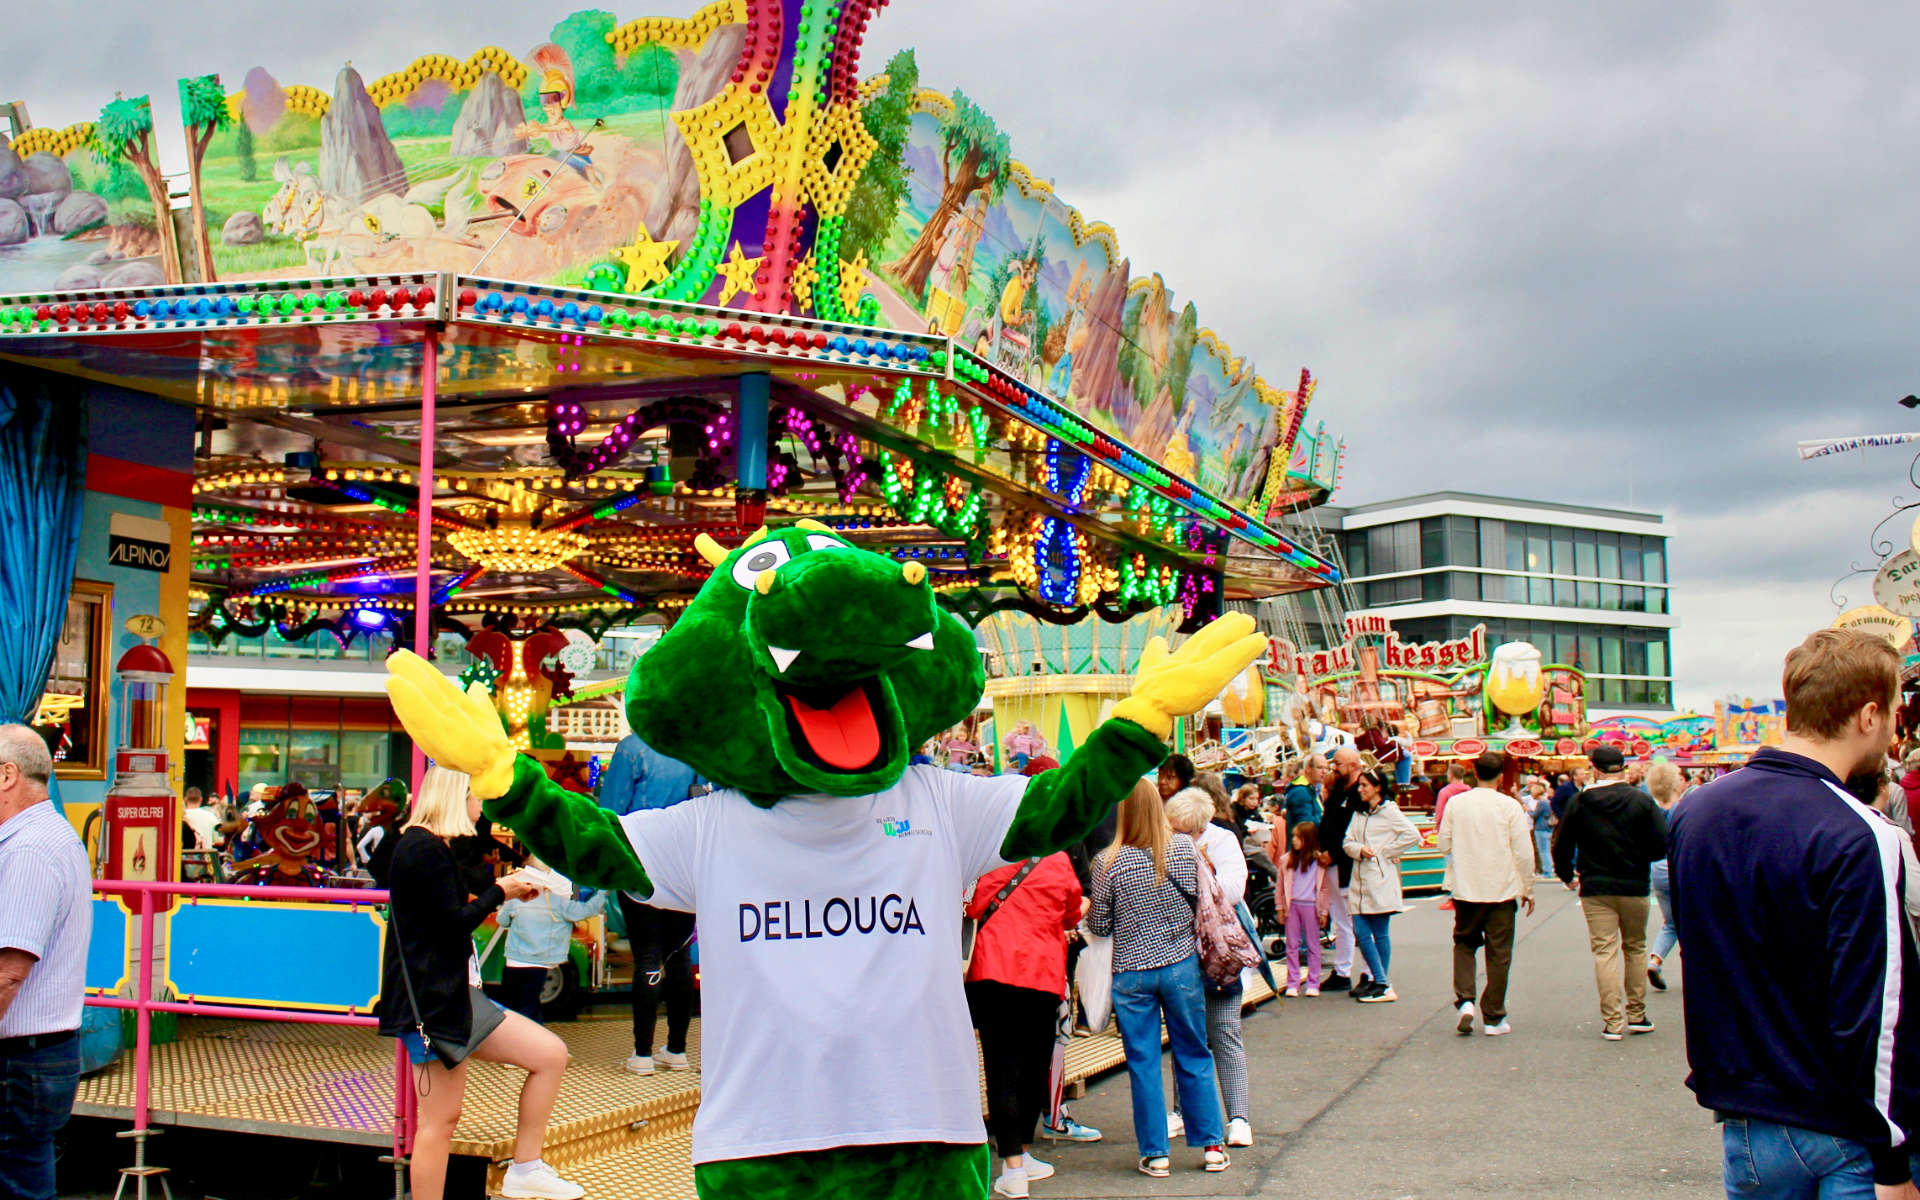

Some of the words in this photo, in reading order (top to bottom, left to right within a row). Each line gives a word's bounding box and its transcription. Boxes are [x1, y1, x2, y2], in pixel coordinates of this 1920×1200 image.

[1385, 627, 1480, 668] kessel
[118, 807, 138, 819] SUPER
[739, 893, 926, 943] DELLOUGA
